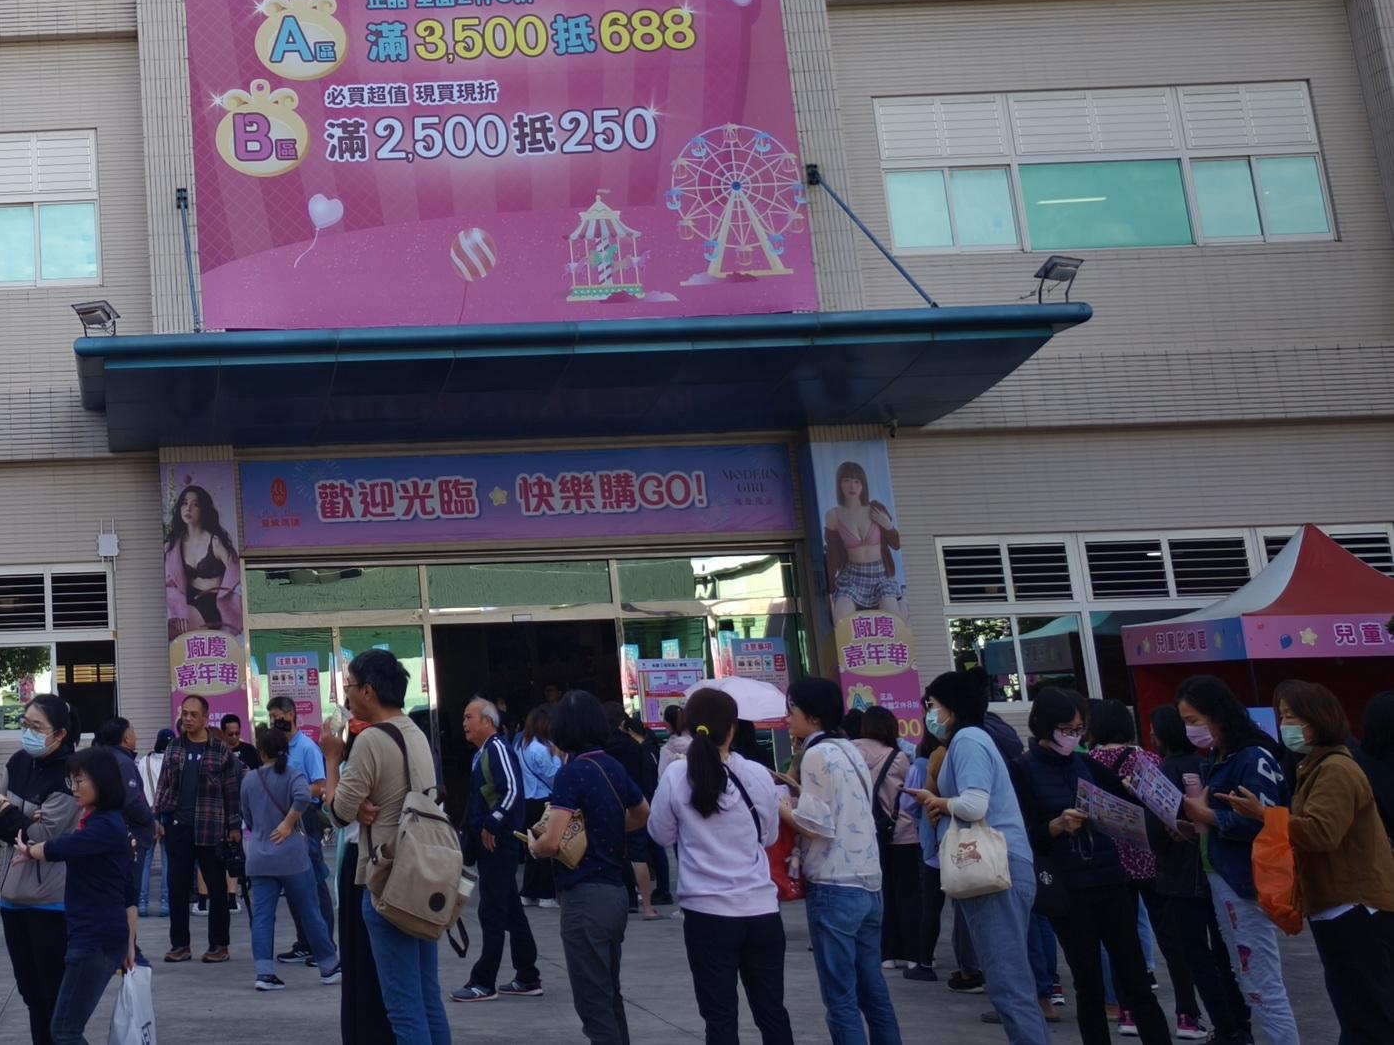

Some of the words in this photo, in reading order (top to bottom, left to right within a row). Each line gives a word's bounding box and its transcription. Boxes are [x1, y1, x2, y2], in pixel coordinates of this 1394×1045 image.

[325, 83, 408, 108] 必買超值
[415, 80, 498, 105] 現買現折
[316, 475, 479, 522] 歡迎光臨
[518, 470, 708, 516] 快樂購GO!
[851, 616, 896, 640] 廠慶
[1333, 622, 1394, 646] 兒童
[185, 635, 228, 659] 廠慶
[842, 643, 909, 669] 嘉年華
[175, 662, 239, 688] 嘉年華
